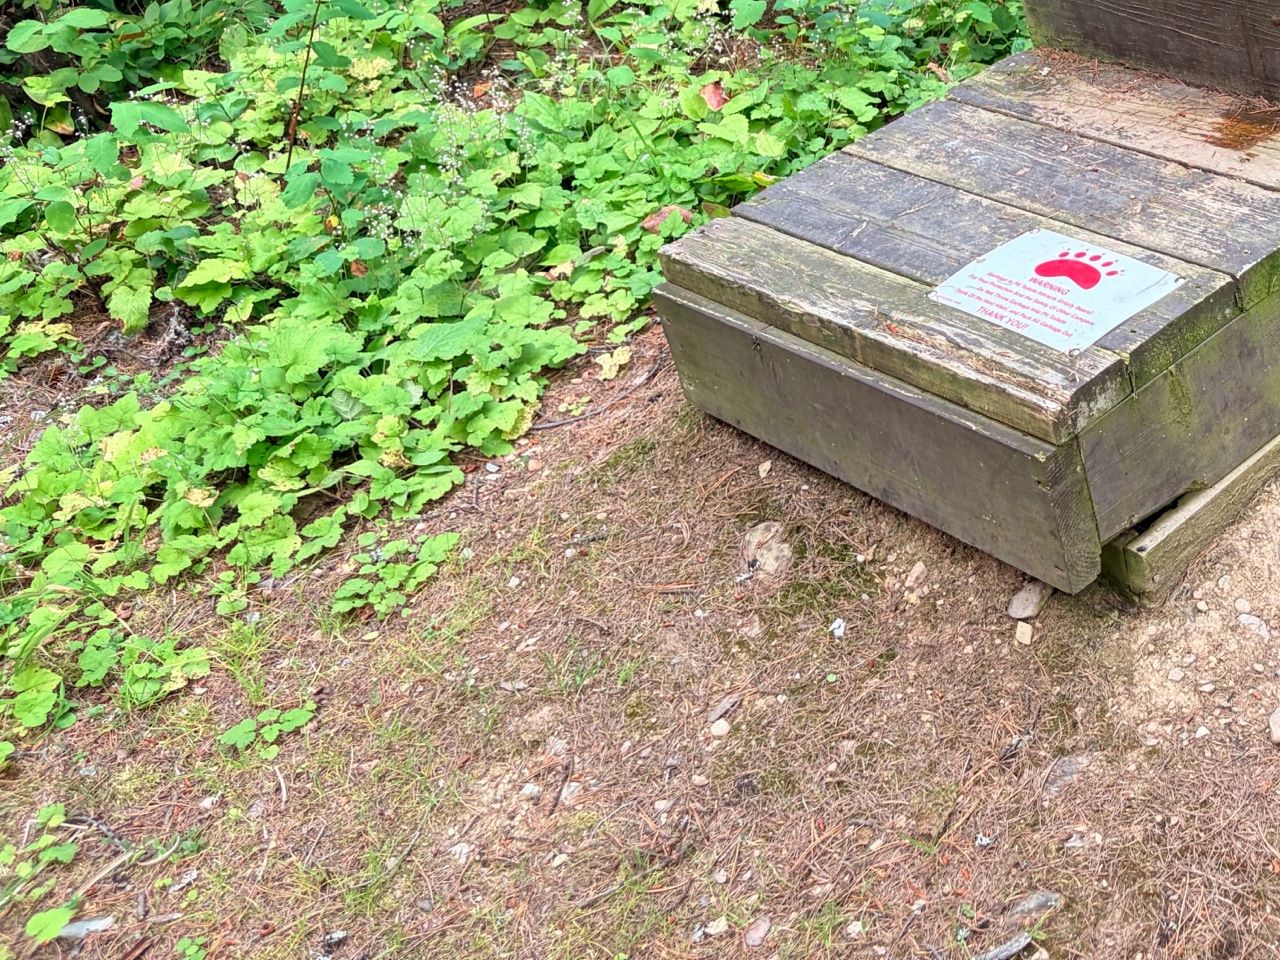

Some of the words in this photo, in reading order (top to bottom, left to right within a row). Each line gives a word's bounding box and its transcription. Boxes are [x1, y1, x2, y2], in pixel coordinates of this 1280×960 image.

[987, 272, 1008, 281] Garbage
[1021, 284, 1037, 293] Toilets
[1037, 291, 1056, 300] Attracts
[1057, 299, 1074, 308] Grizzly
[1029, 277, 1070, 295] WARNING
[989, 282, 1013, 293] Protection
[1033, 299, 1049, 307] Safety
[1056, 308, 1071, 316] Other
[1071, 314, 1094, 326] Campers
[994, 293, 1009, 301] Throw
[1009, 299, 1030, 309] Garbage
[1049, 315, 1066, 324] Toilets
[977, 306, 1007, 321] THANK
[1006, 318, 1029, 330] YOU!
[1040, 322, 1062, 333] Garbage
